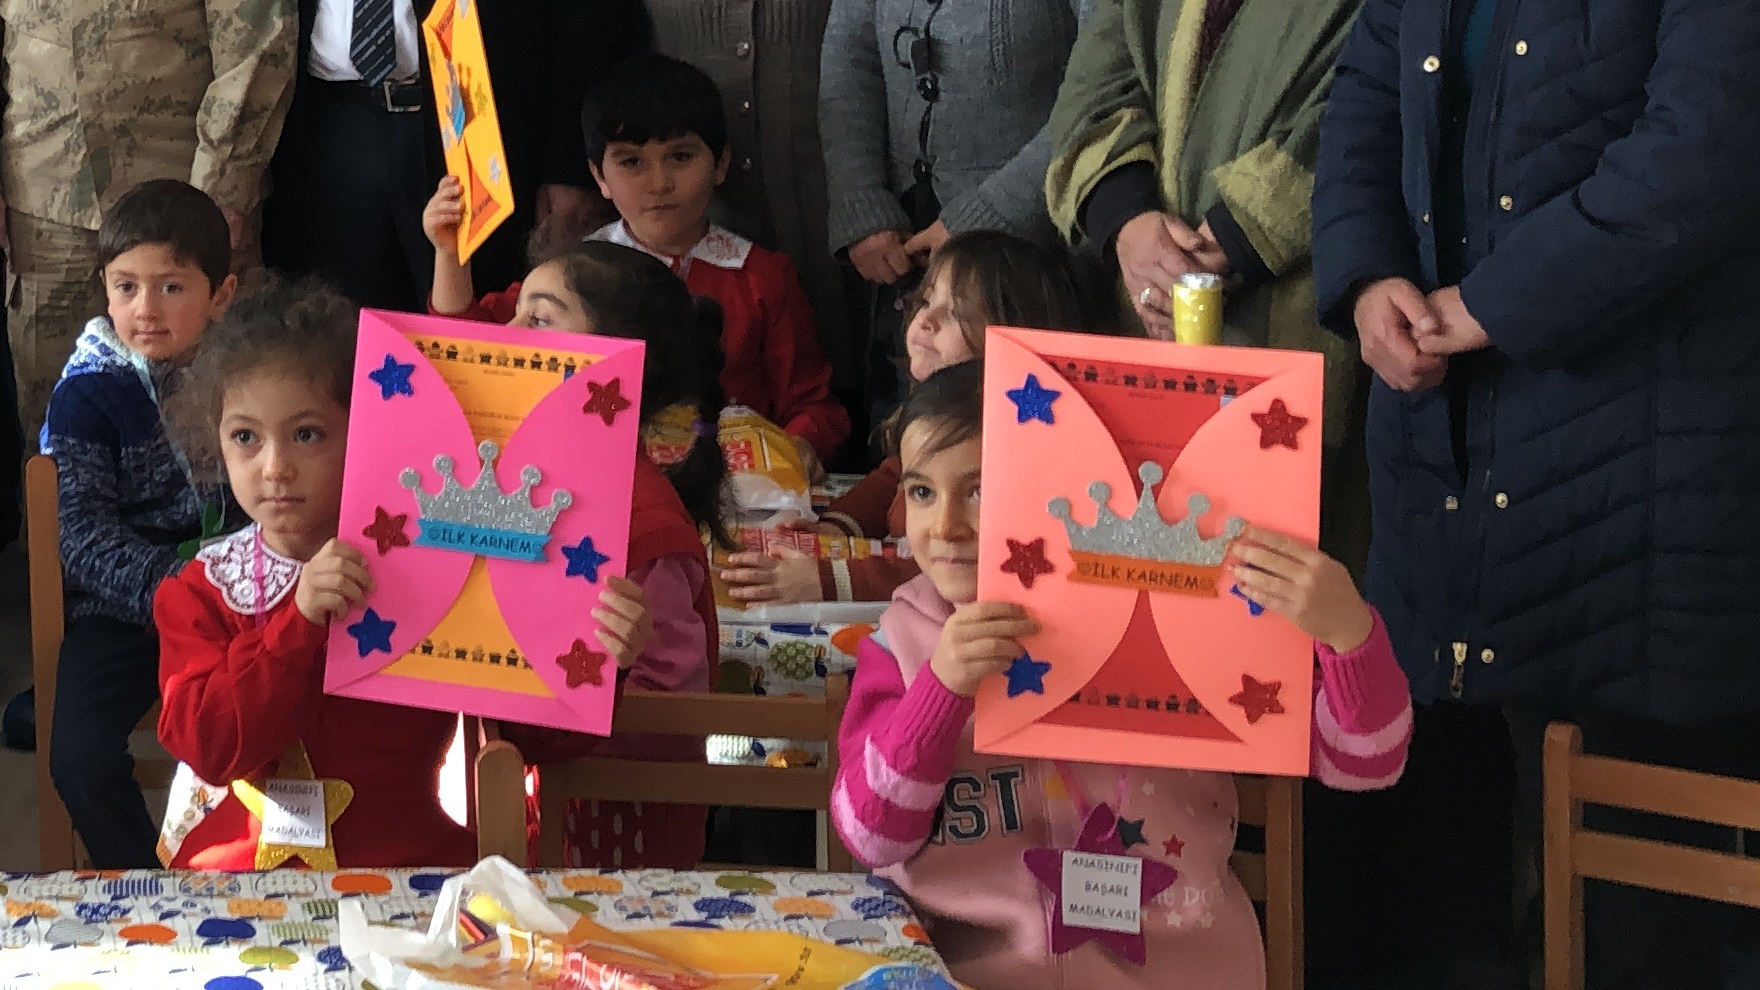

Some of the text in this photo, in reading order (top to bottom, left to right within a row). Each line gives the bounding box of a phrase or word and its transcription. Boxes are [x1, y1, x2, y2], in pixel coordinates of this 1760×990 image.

[470, 532, 533, 555] KARNEM
[1125, 567, 1200, 590] KARNEM
[929, 765, 1024, 845] ST
